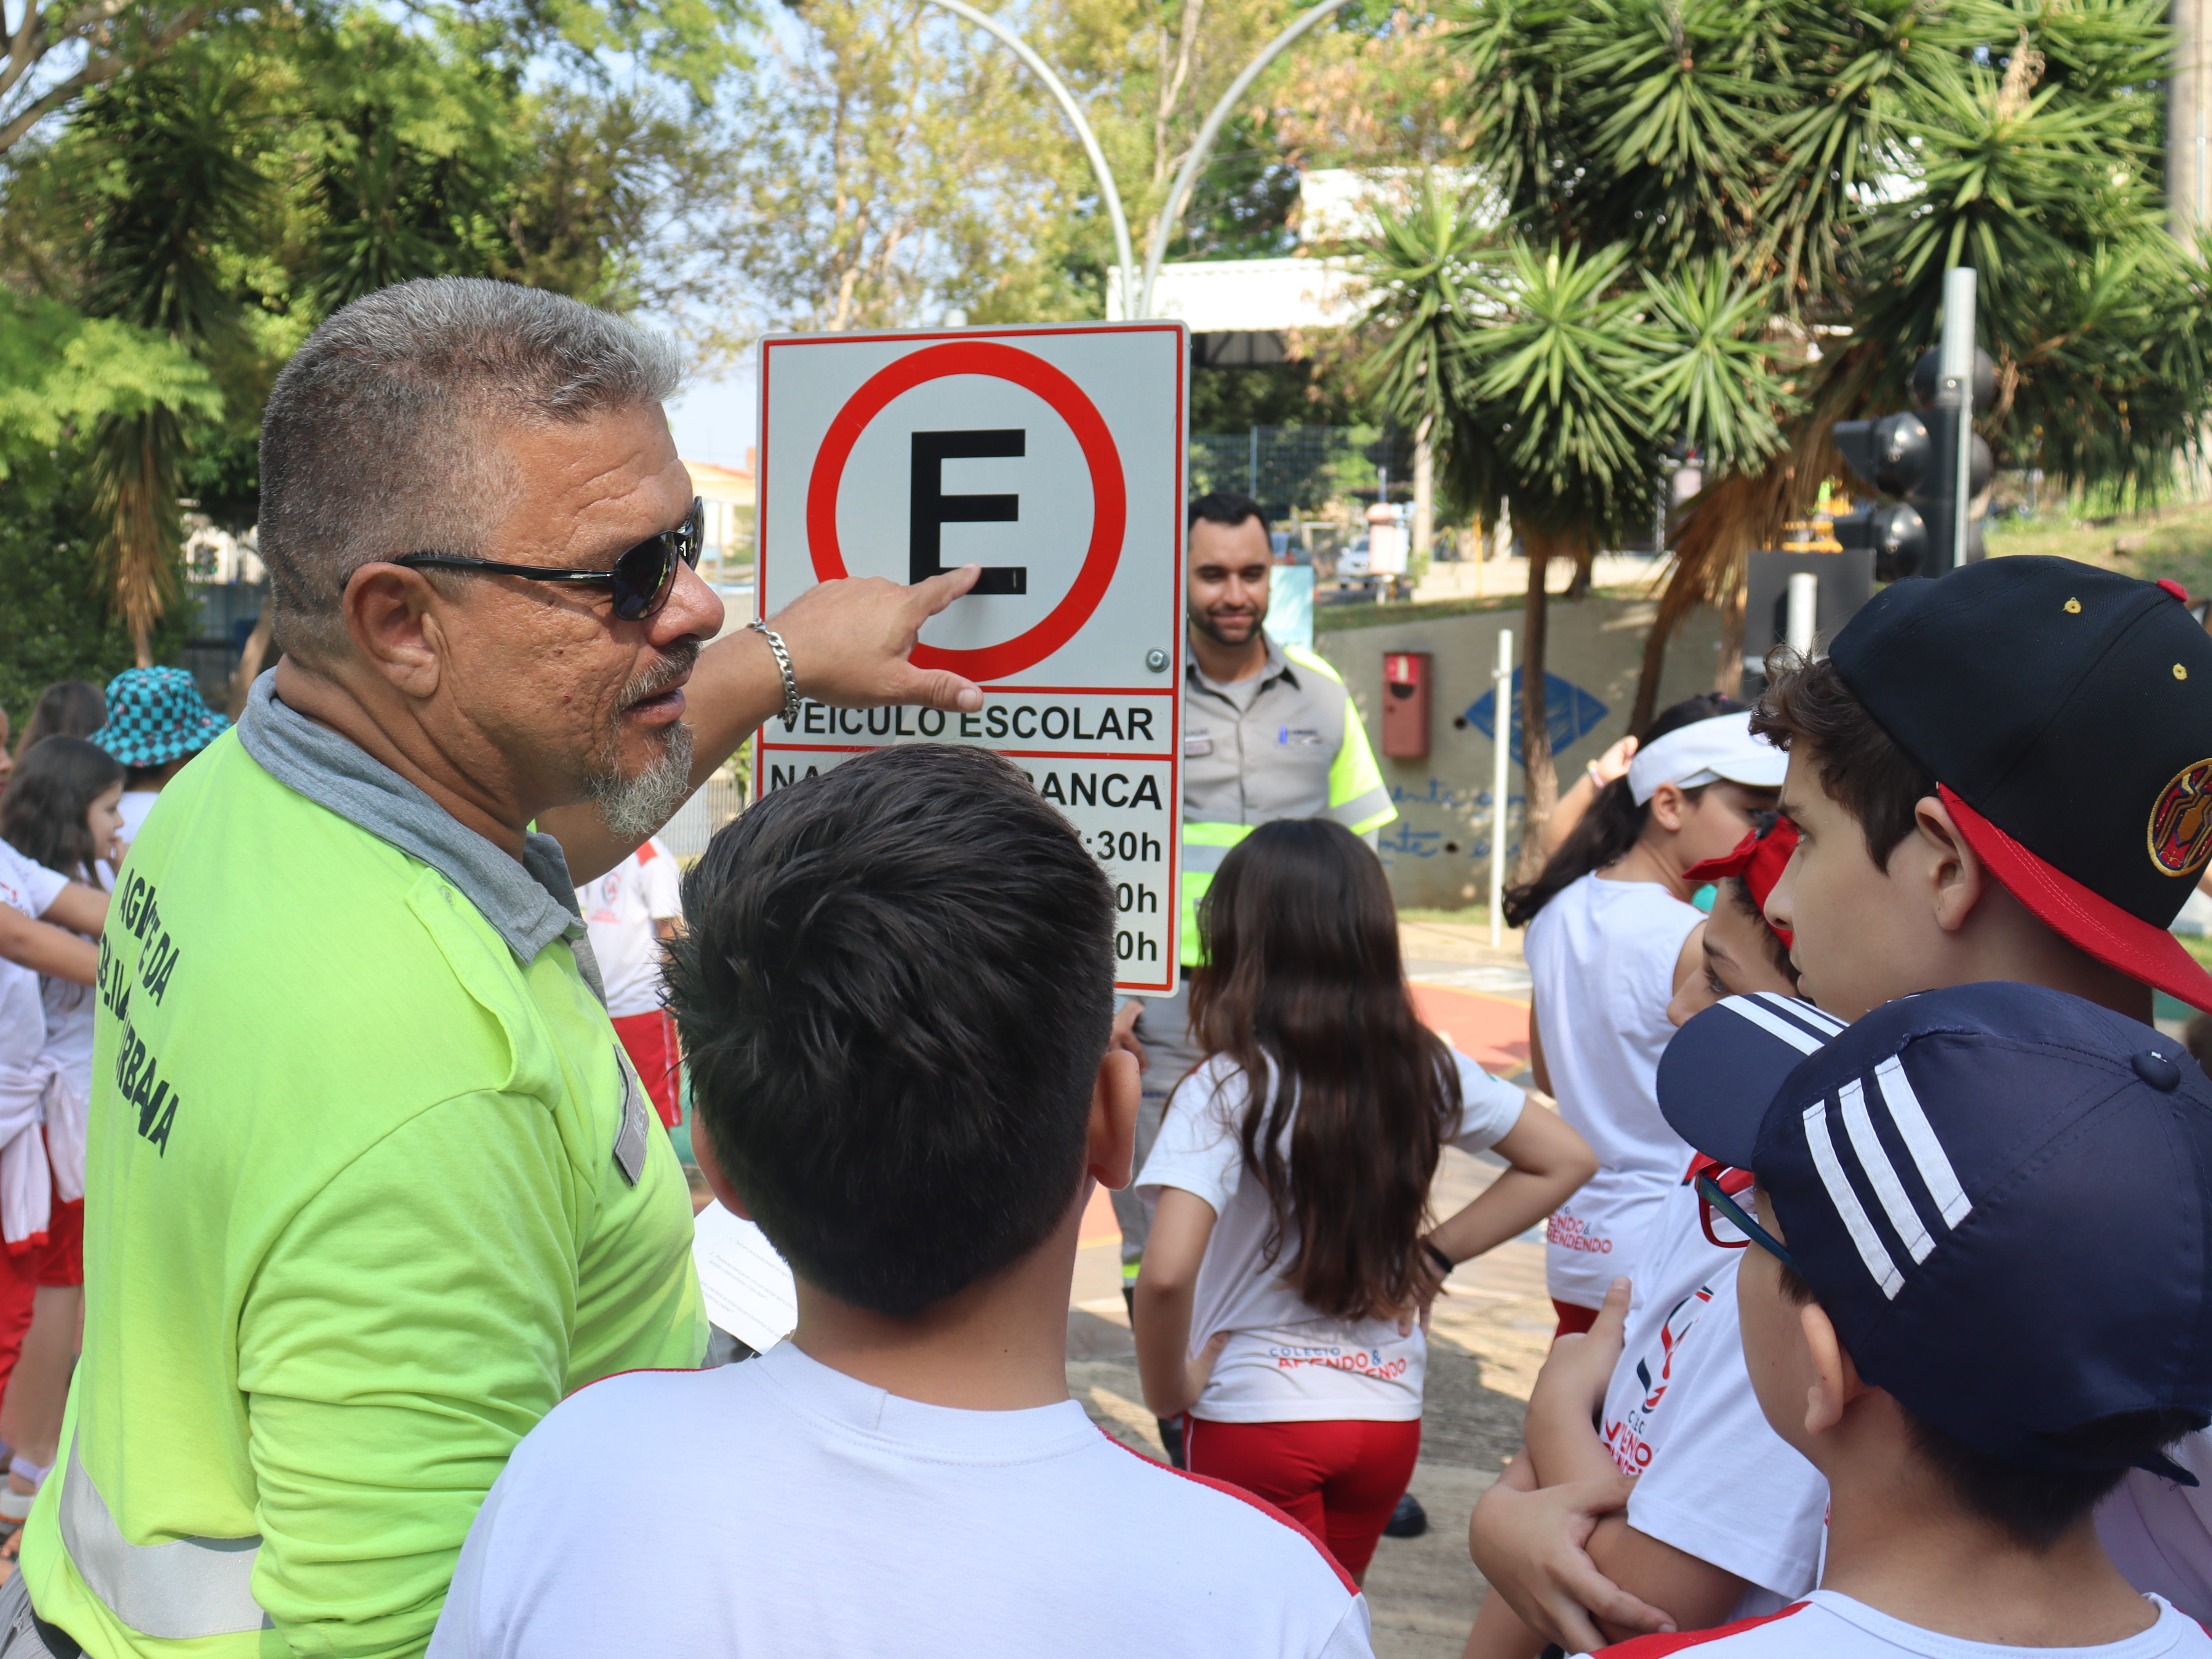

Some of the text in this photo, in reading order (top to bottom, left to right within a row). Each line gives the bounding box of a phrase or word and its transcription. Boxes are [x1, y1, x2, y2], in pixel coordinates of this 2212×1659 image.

[910, 429, 1027, 594] E
[960, 705, 1154, 740] ESCOLAR
[1025, 772, 1162, 810] ANCA
[142, 931, 179, 1007] DA
